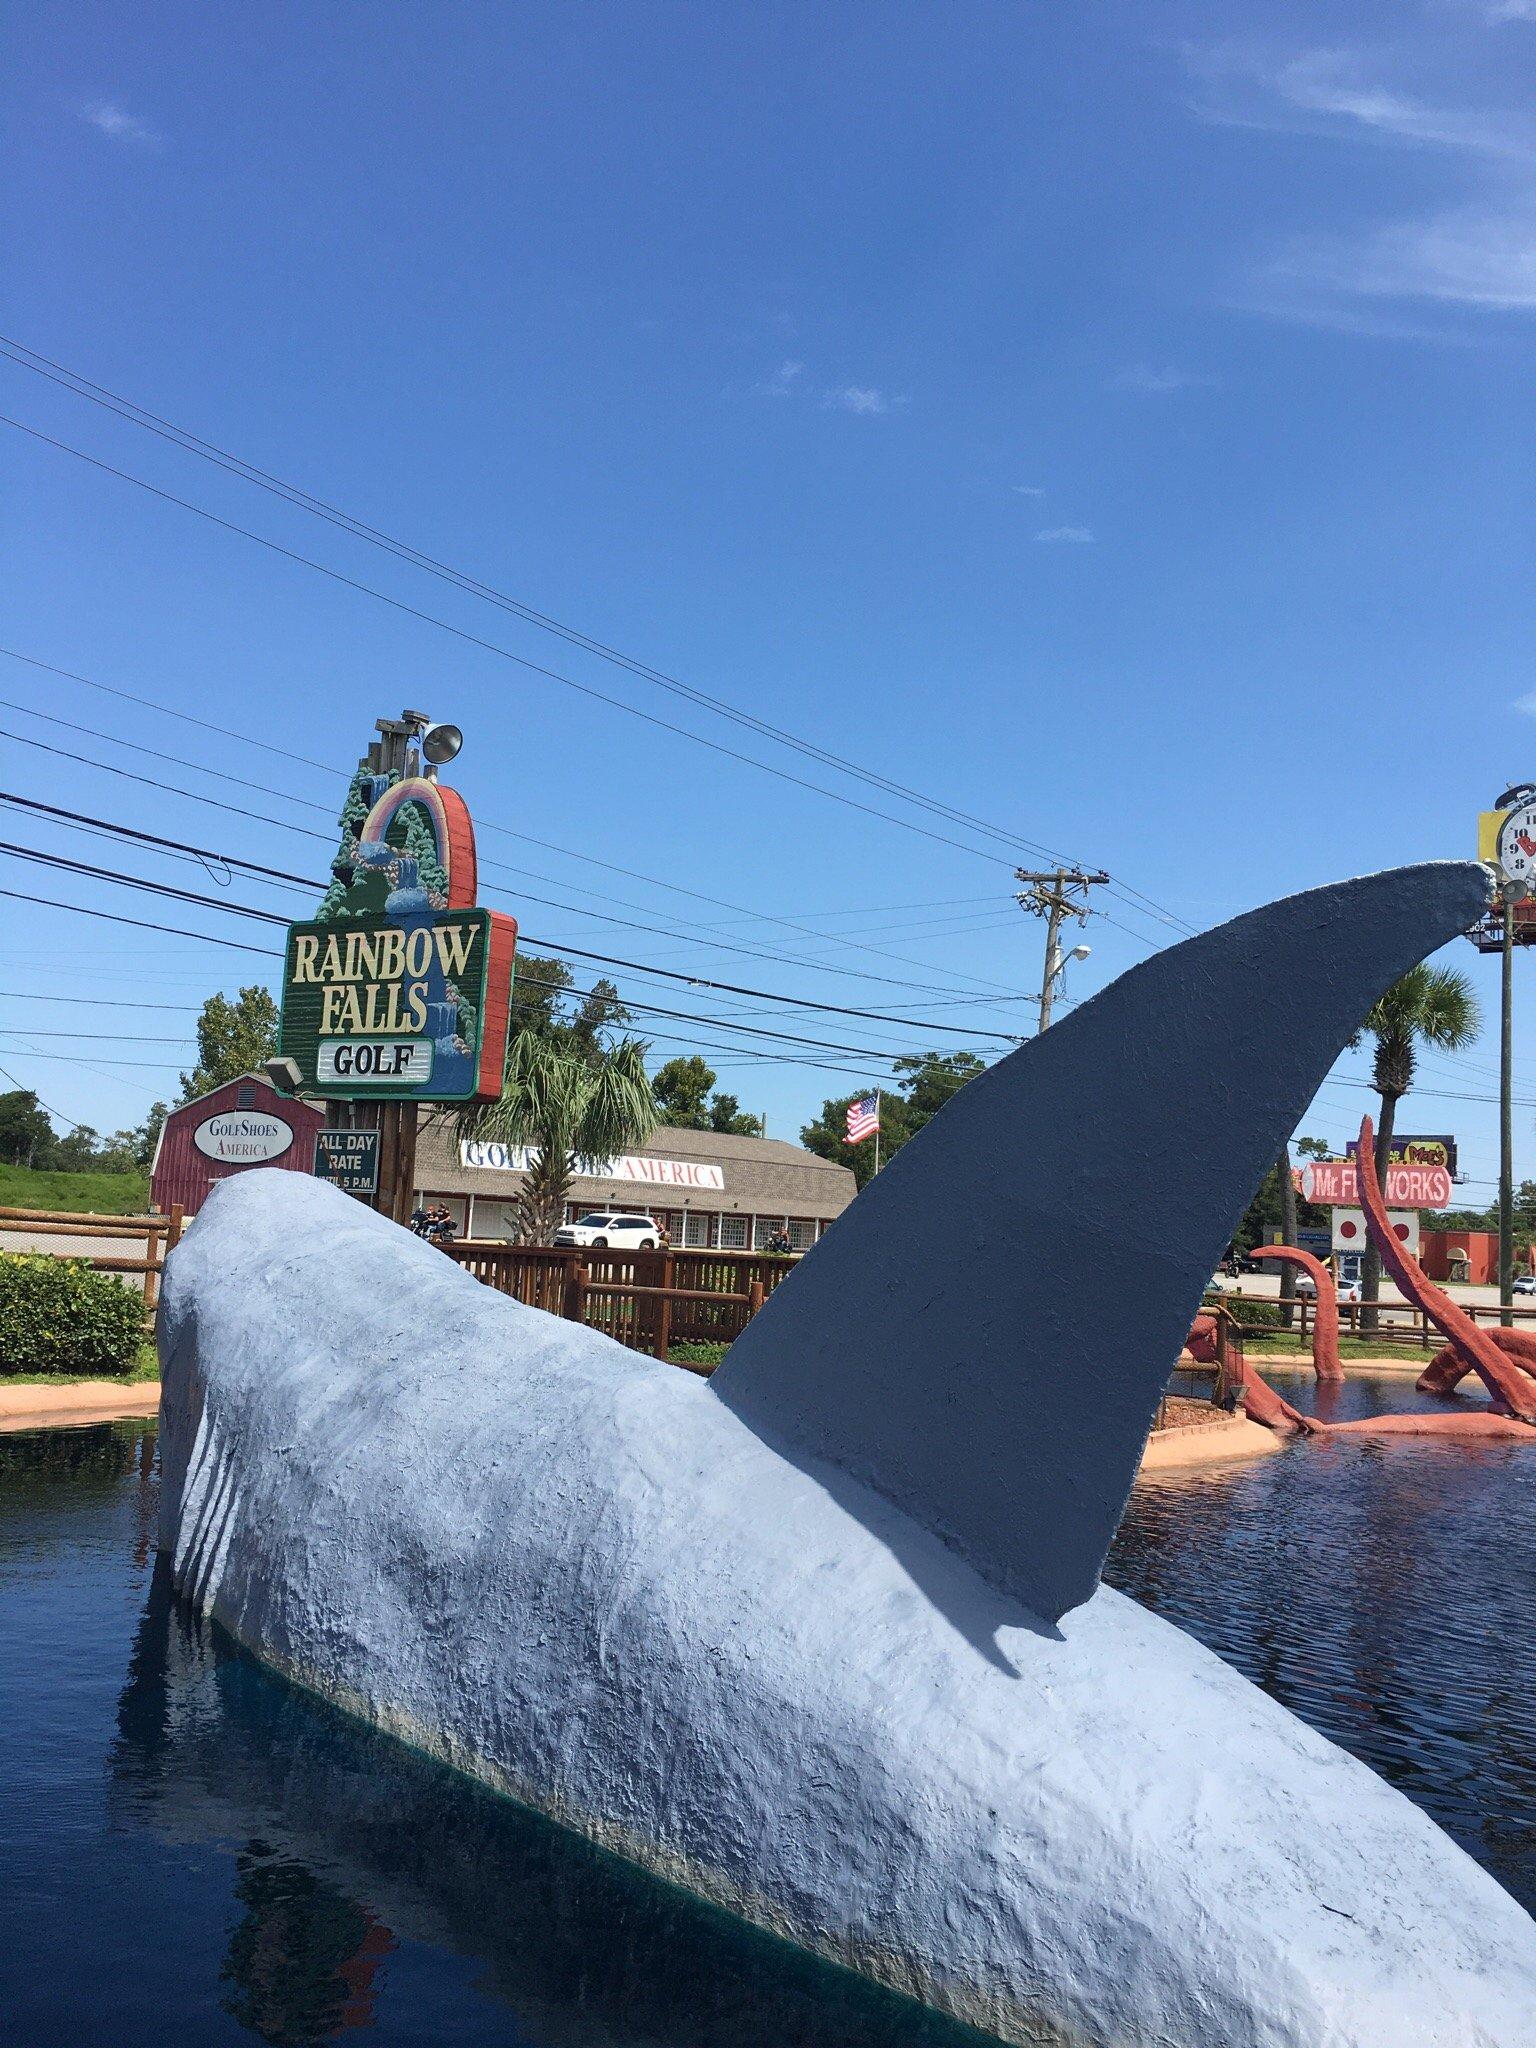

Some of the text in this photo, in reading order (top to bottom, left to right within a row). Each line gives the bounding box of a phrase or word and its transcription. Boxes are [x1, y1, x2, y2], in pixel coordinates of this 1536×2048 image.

[1509, 843, 1519, 854] 9
[1515, 858, 1525, 869] 8
[292, 924, 480, 983] RAINBOW
[318, 982, 429, 1034] FALLS
[334, 1044, 414, 1075] GOLF
[215, 1138, 268, 1156] AMERICA
[319, 1135, 374, 1151] ALL DAY
[328, 1154, 362, 1170] RATE
[624, 1159, 719, 1187] AMERICA
[343, 1176, 350, 1187] 5
[352, 1177, 373, 1188] P.M.
